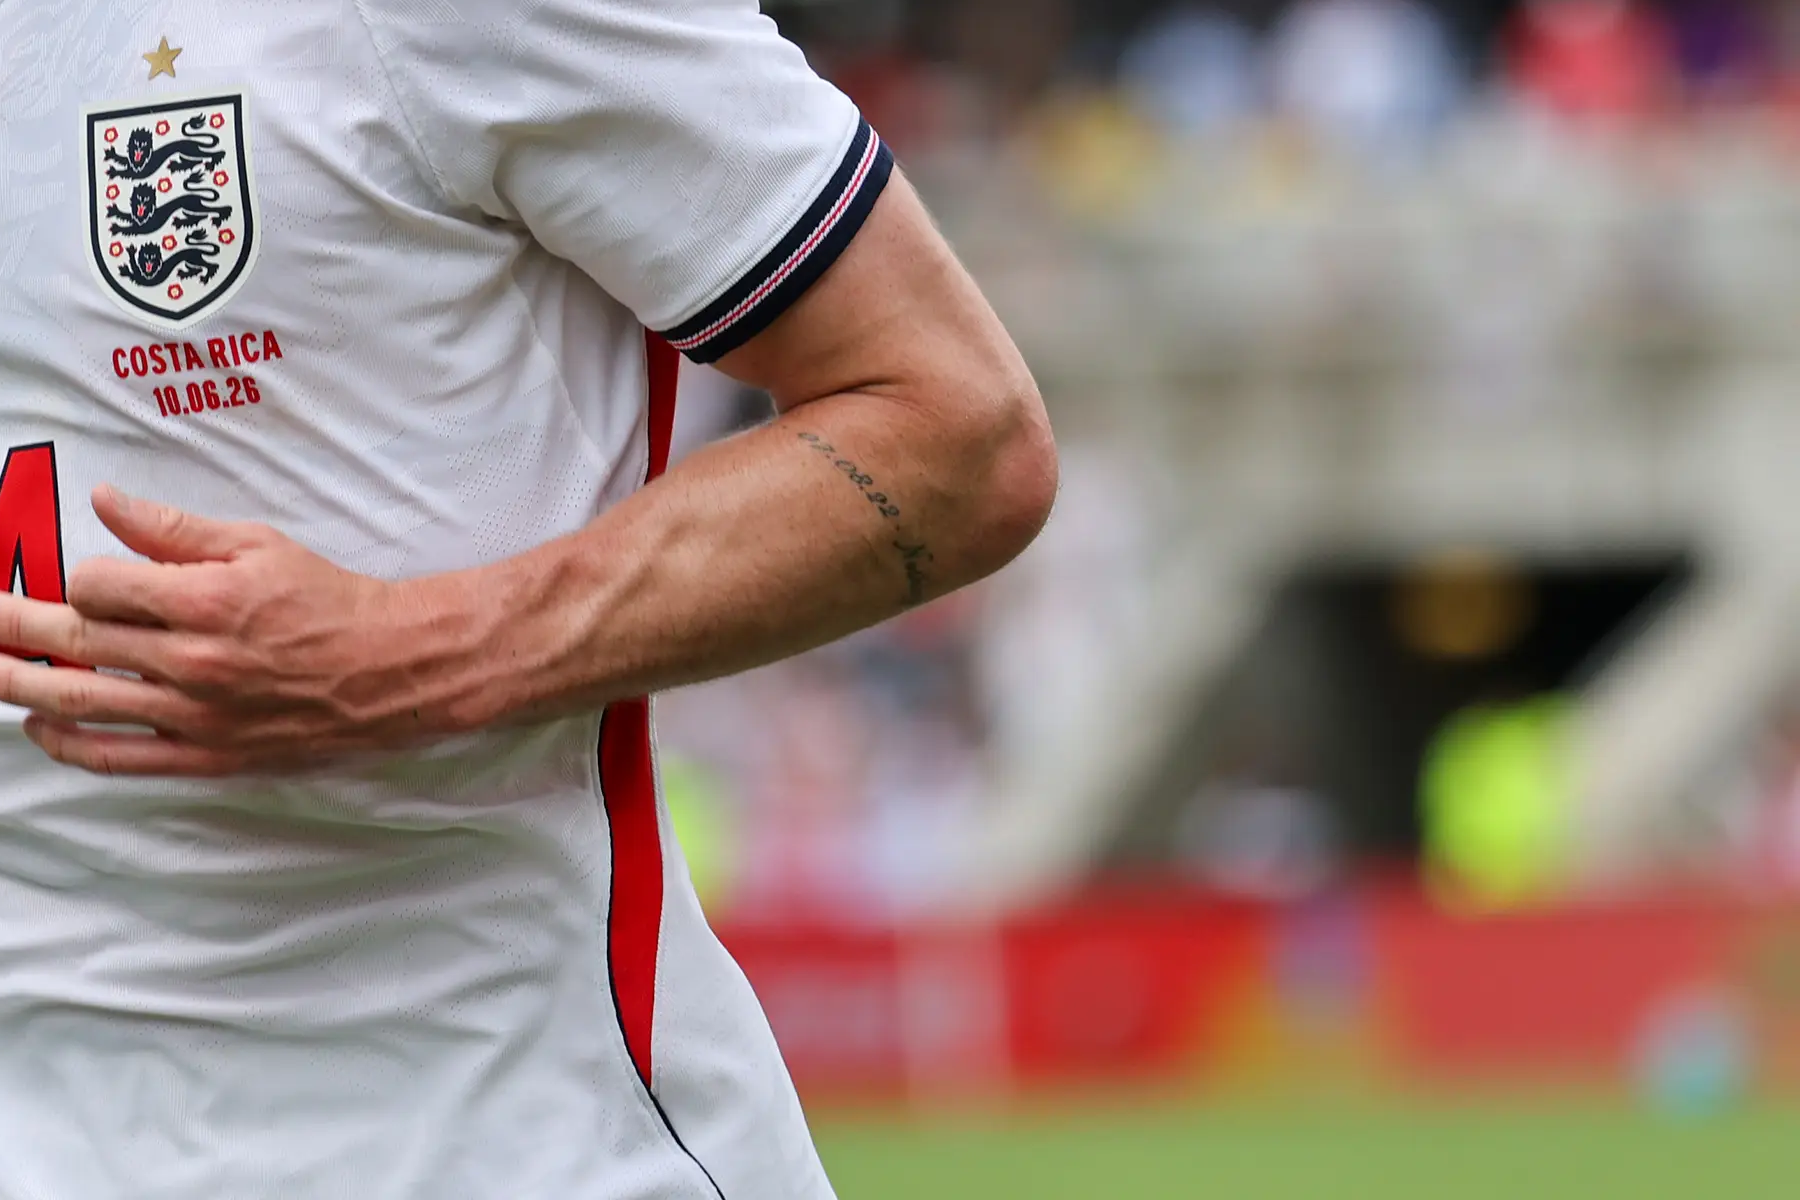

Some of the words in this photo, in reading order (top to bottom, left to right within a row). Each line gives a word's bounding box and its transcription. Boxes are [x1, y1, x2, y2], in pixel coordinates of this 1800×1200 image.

[111, 342, 206, 380] COSTA
[207, 330, 283, 369] RICA
[153, 376, 262, 417] 10.06.26
